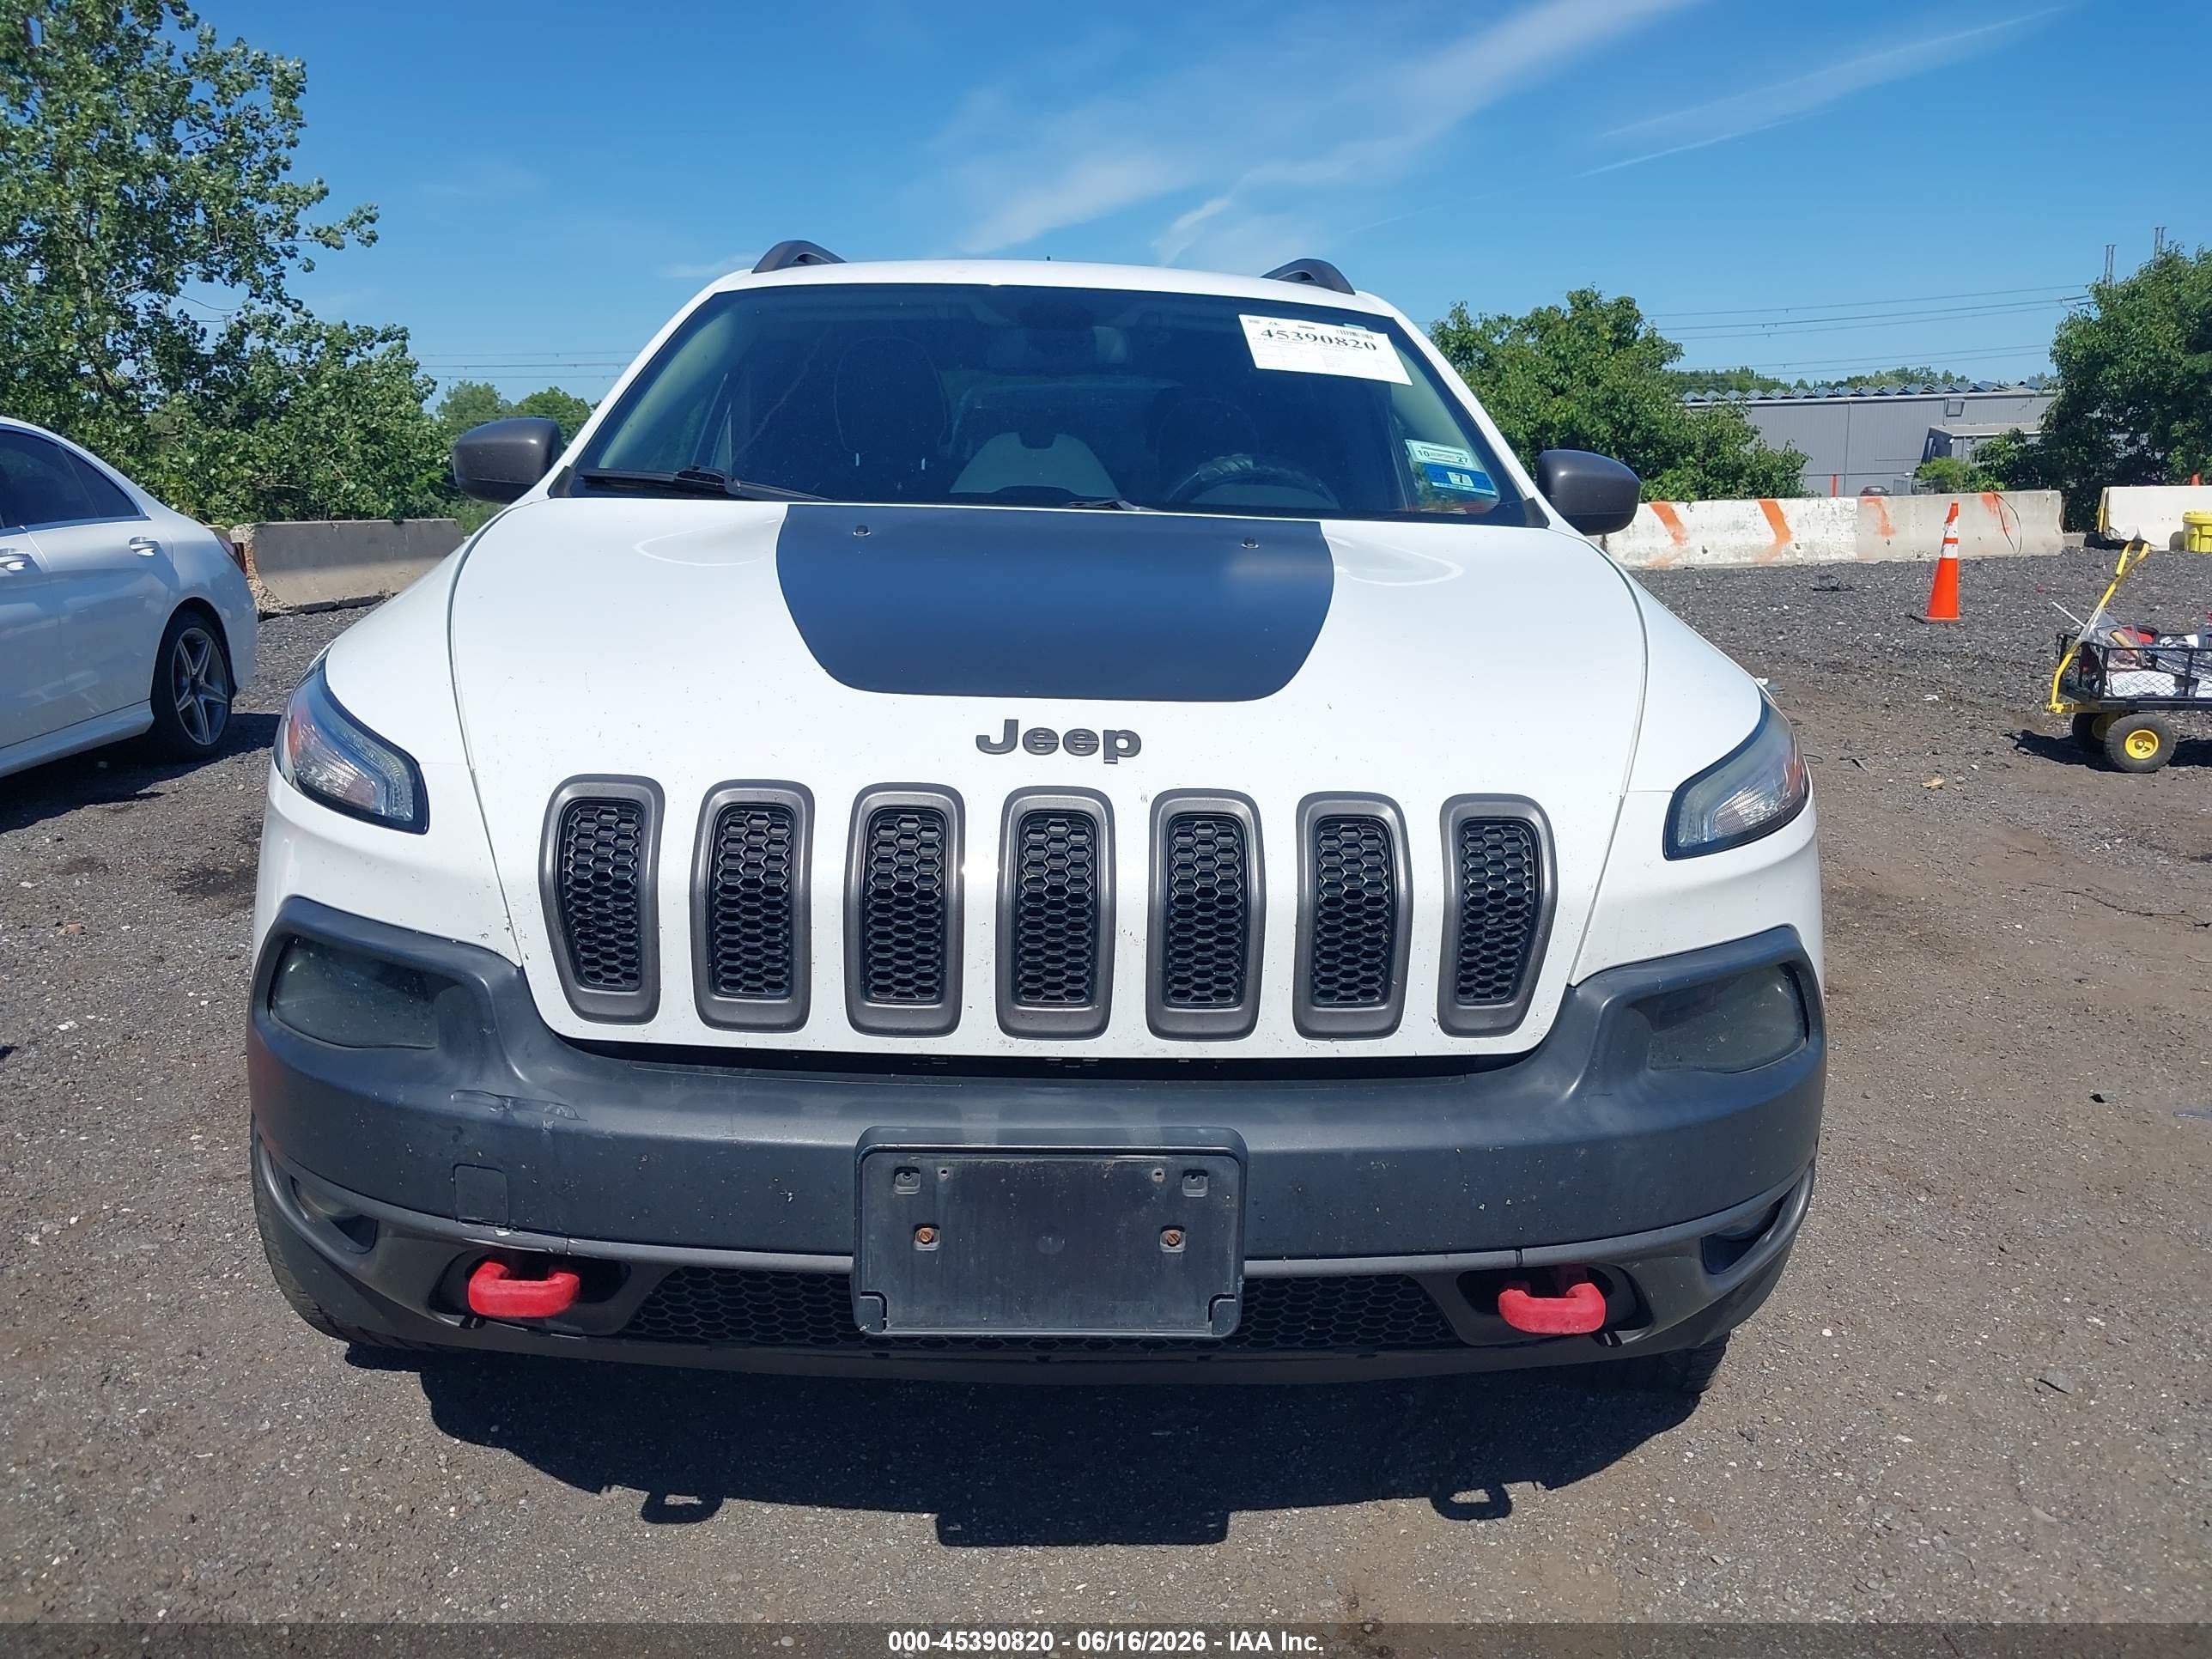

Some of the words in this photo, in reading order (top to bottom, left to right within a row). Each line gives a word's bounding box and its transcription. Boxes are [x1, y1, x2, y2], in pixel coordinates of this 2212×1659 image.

[1261, 329, 1377, 351] 45390820
[1455, 473, 1464, 483] 7
[975, 719, 1142, 765] Jeep
